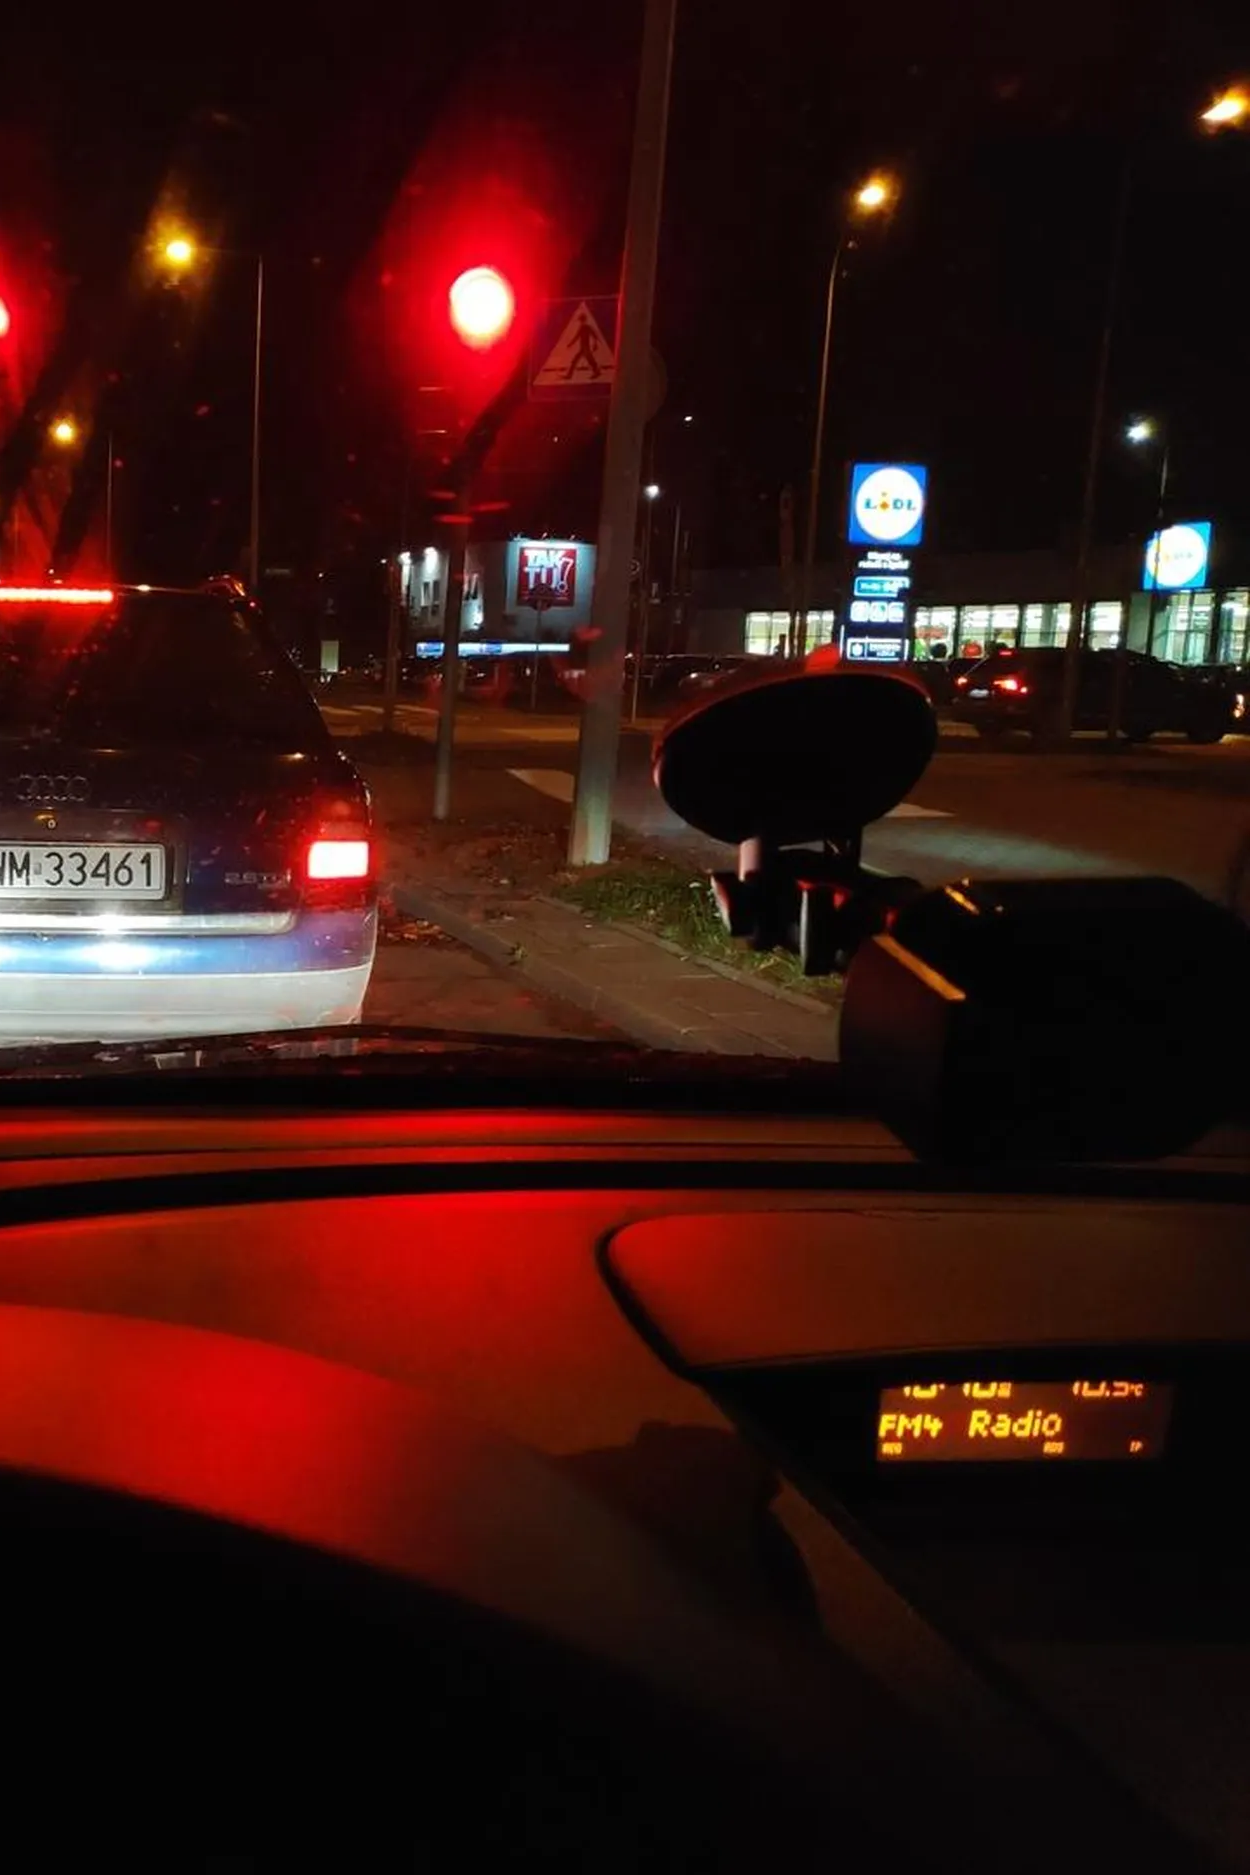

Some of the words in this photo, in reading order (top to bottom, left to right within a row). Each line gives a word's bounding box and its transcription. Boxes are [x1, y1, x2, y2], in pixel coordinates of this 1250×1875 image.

[44, 851, 153, 887] 33461
[879, 1413, 943, 1438] FM4
[968, 1409, 1063, 1438] Radio
